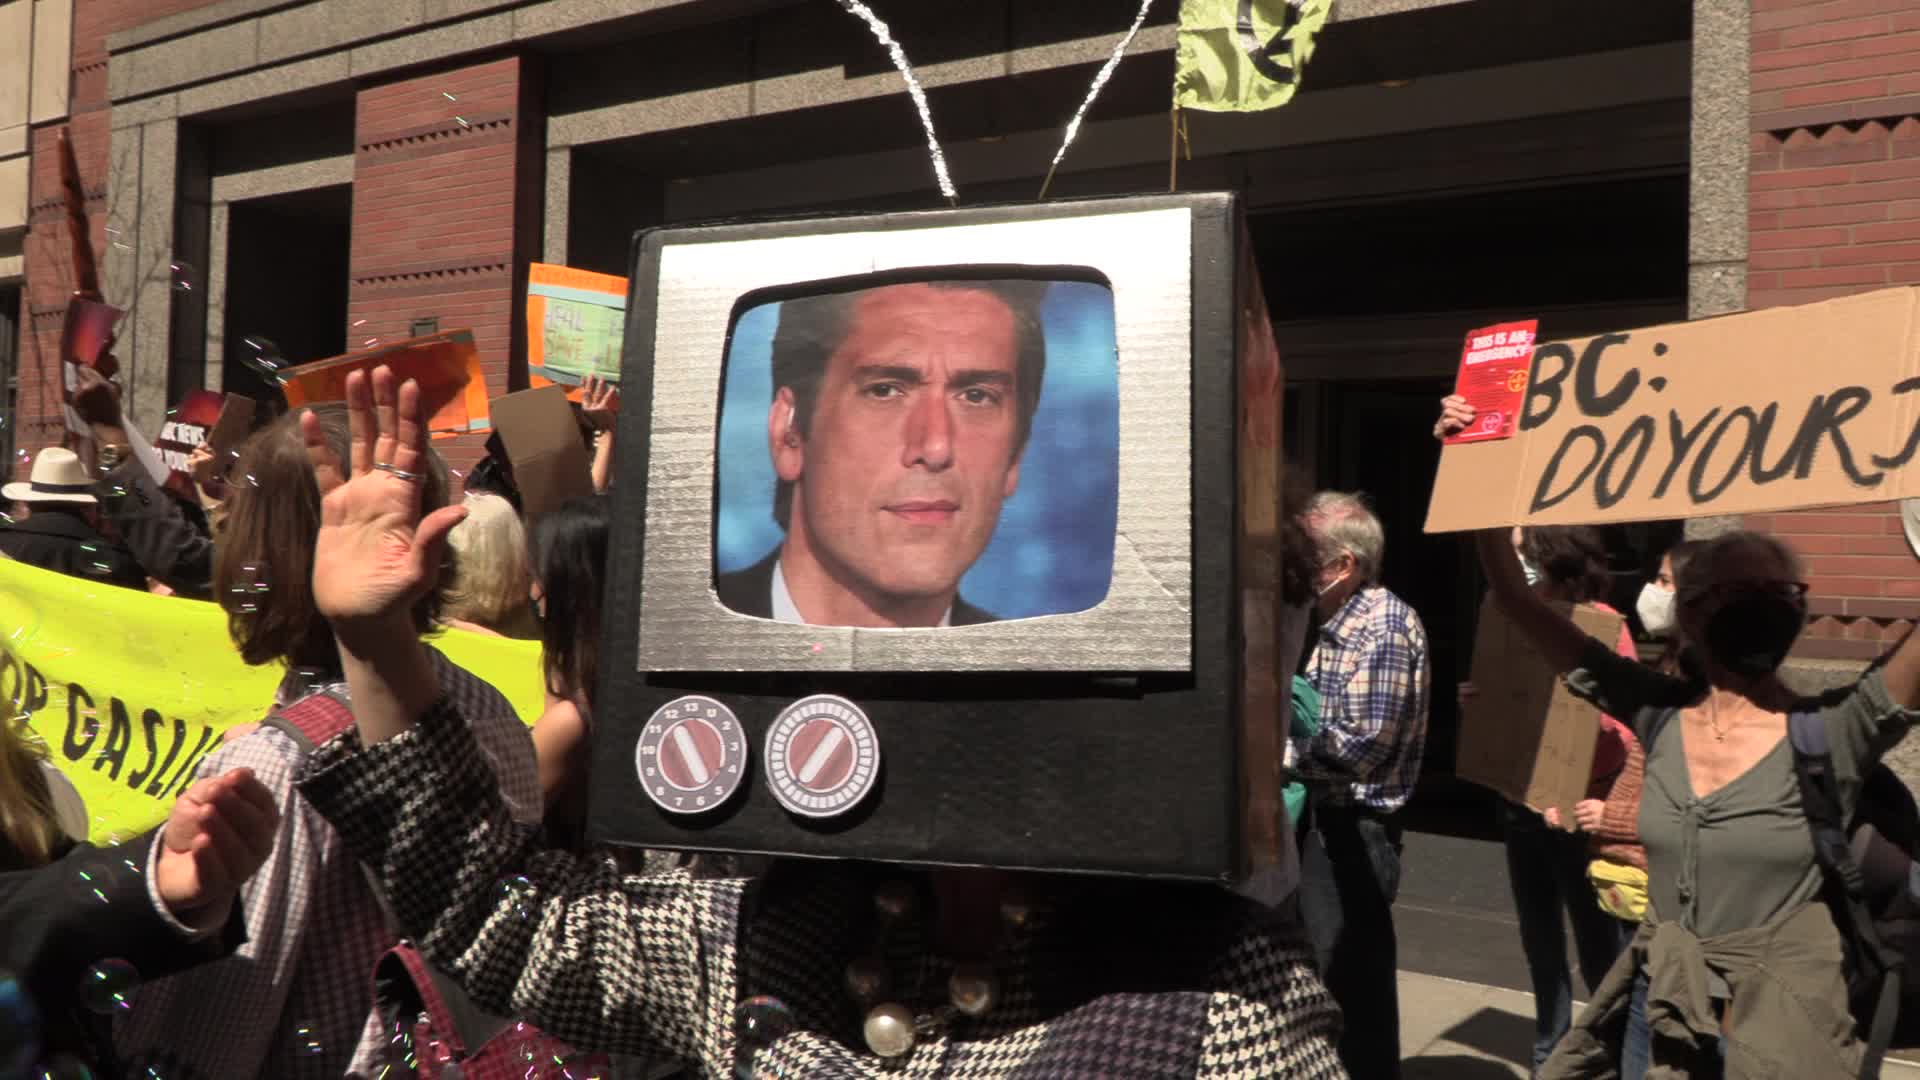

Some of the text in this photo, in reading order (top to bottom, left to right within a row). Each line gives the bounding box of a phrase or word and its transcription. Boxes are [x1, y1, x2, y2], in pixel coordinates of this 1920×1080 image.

[1471, 329, 1528, 350] THIS IS AN
[1465, 344, 1530, 365] EMERGENCY
[684, 703, 699, 712] 13
[664, 709, 679, 719] 12
[648, 725, 662, 733] 11
[721, 721, 731, 731] 2
[641, 745, 656, 755] 10
[730, 742, 739, 752] 3
[646, 767, 655, 777] 9
[727, 764, 737, 774] 4
[656, 786, 665, 796] 8
[715, 786, 724, 795] 5
[674, 797, 684, 806] 7
[696, 796, 706, 806] 6
